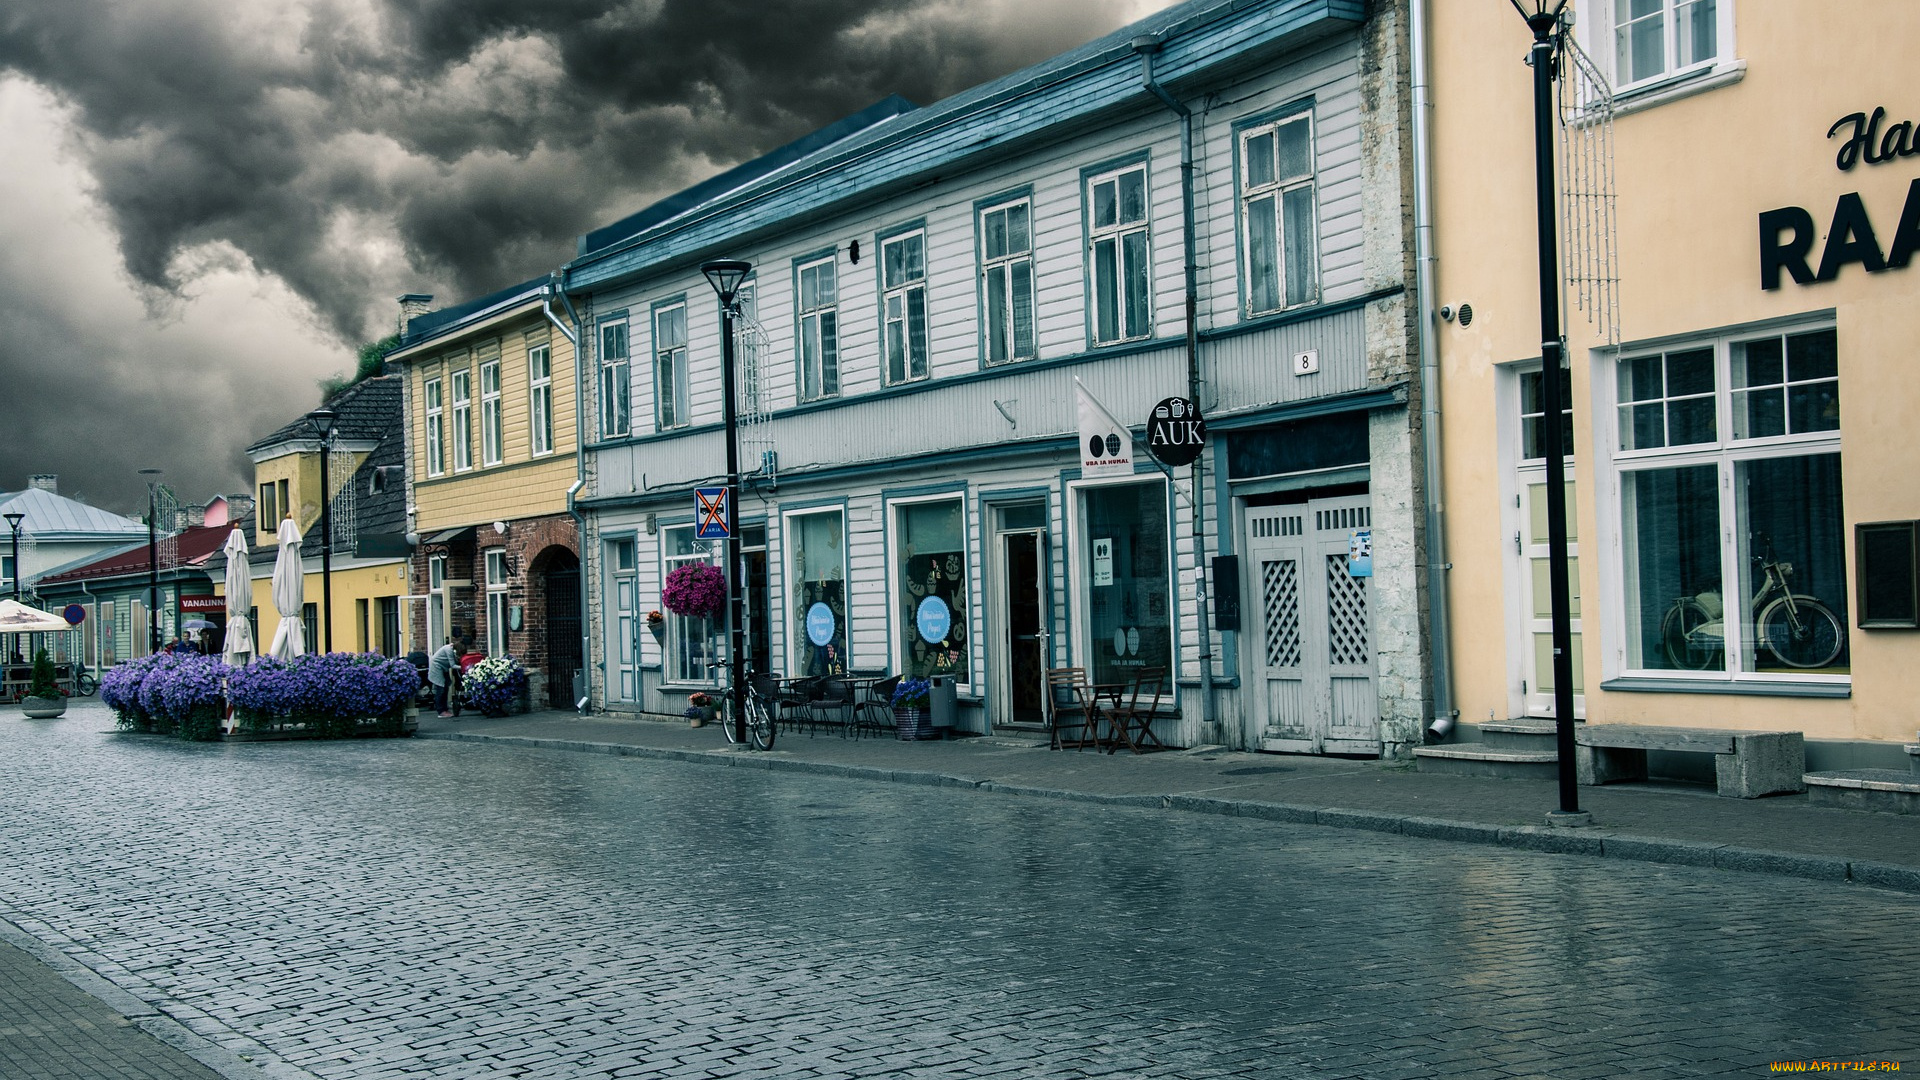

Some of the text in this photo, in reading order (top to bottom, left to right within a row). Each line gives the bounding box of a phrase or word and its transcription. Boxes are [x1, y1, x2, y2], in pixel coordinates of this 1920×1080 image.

[1827, 106, 1920, 171] Ha
[1302, 355, 1309, 369] 8
[1151, 421, 1204, 445] AUK
